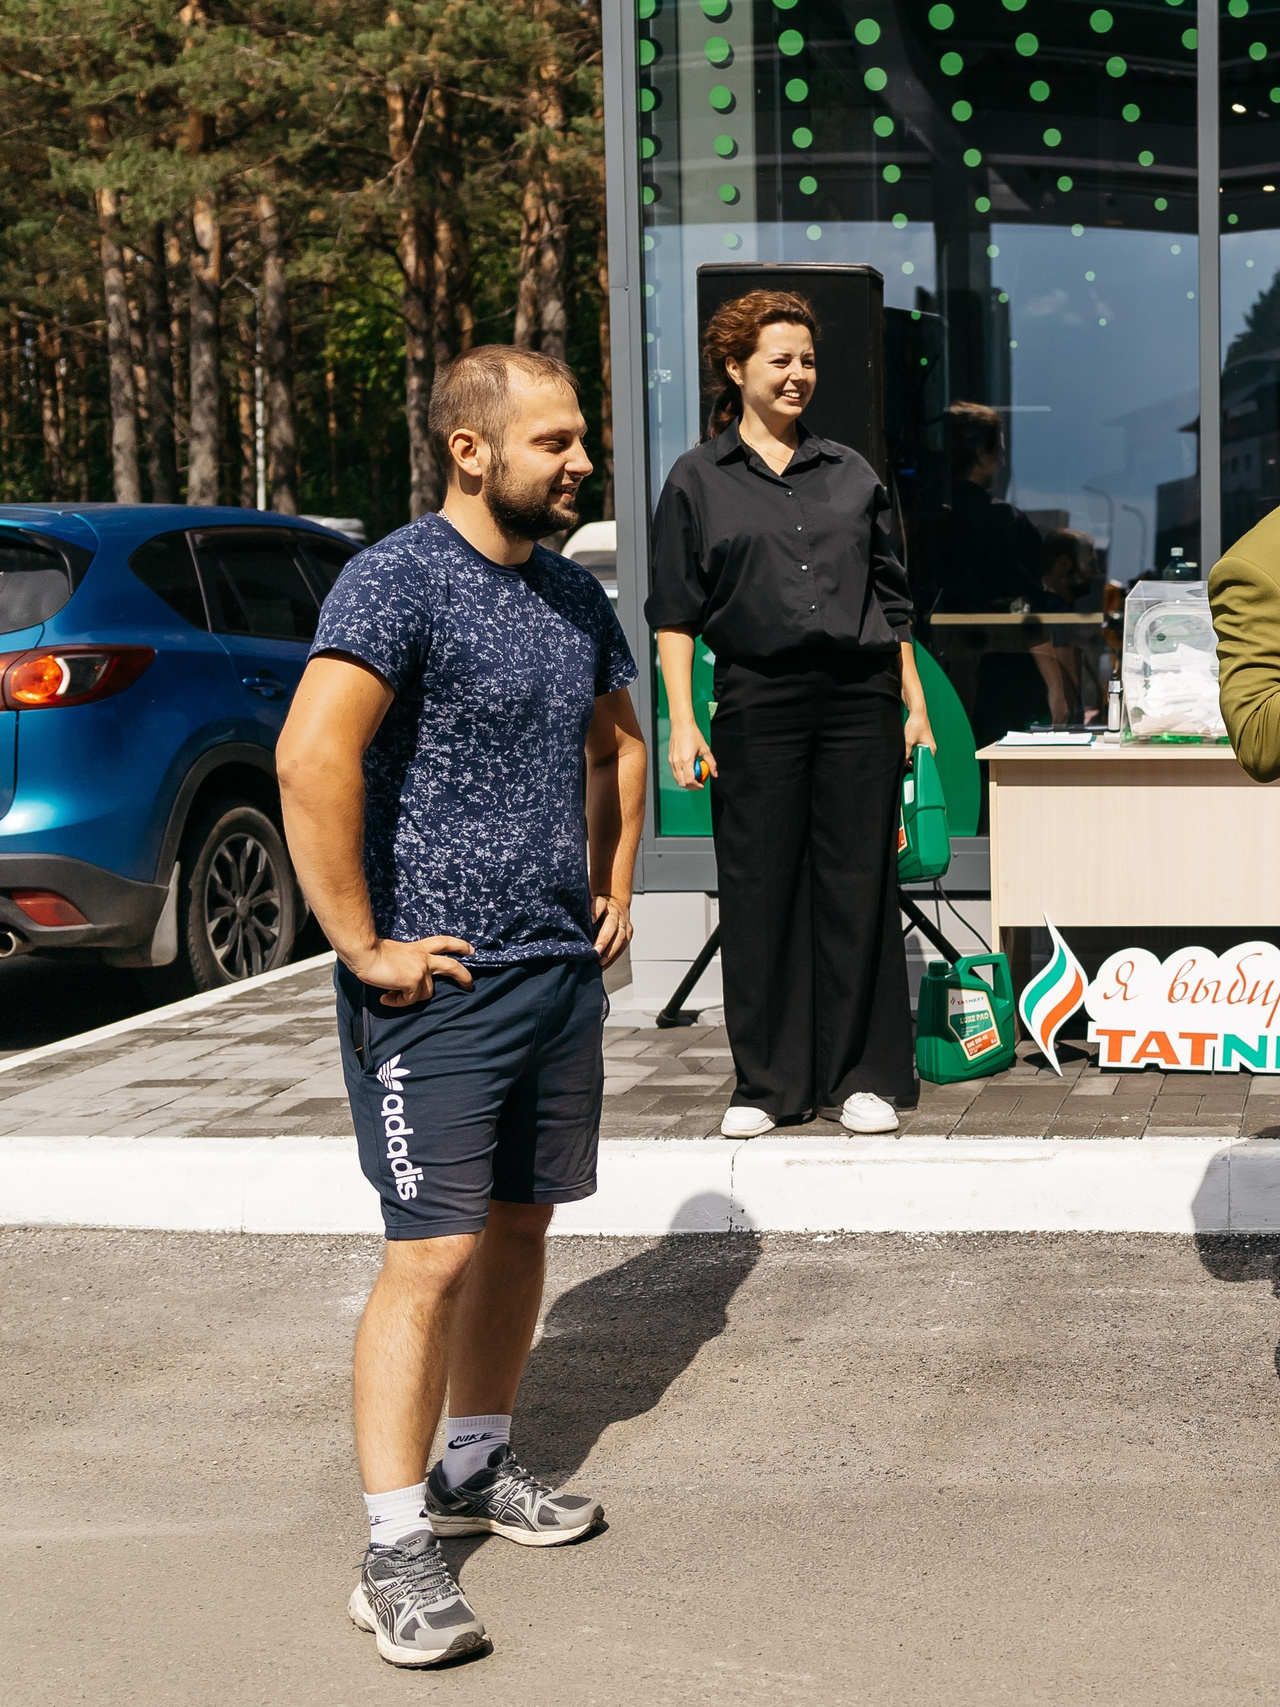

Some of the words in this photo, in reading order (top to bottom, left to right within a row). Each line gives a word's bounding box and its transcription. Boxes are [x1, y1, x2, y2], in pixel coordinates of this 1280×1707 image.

[1103, 960, 1140, 1001] Я
[957, 996, 984, 1006] TATNEFT
[960, 1014, 976, 1024] LUXE
[454, 1431, 494, 1443] NIKE
